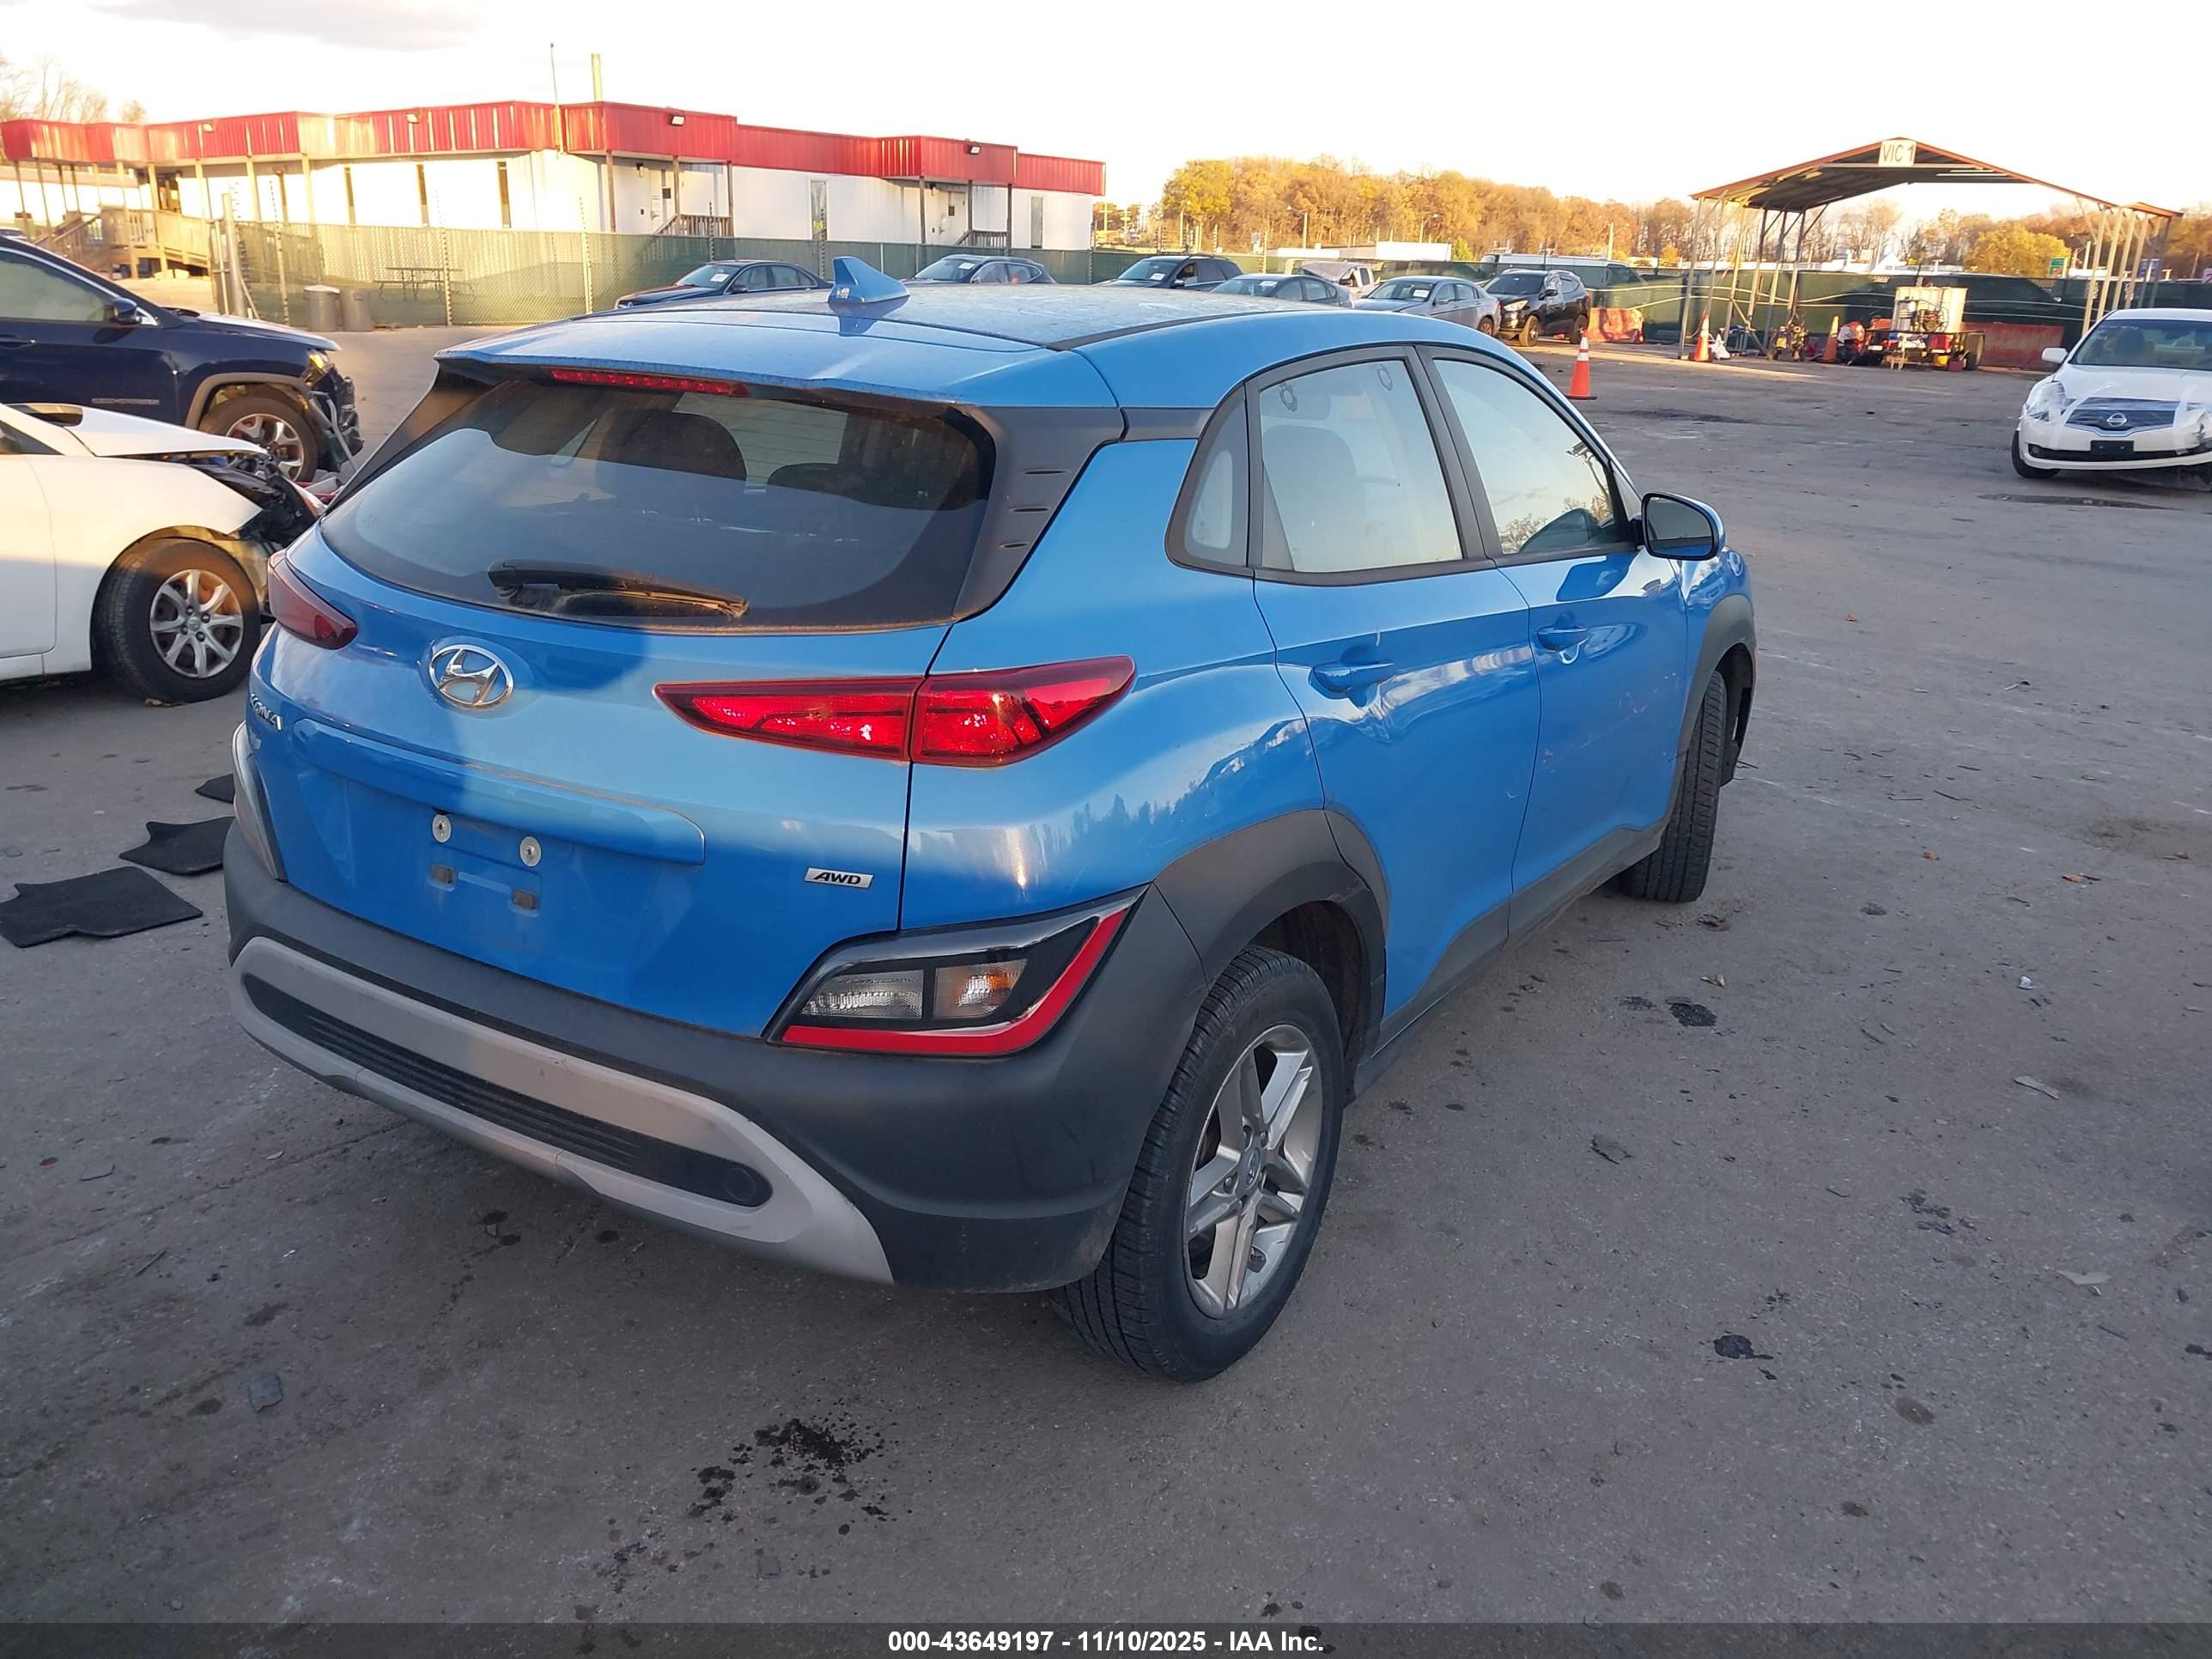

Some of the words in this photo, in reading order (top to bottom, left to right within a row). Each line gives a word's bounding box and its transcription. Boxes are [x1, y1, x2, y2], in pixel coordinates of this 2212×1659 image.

[1883, 143, 1904, 162] VIC
[1908, 143, 1915, 162] 1
[813, 872, 861, 884] AWD
